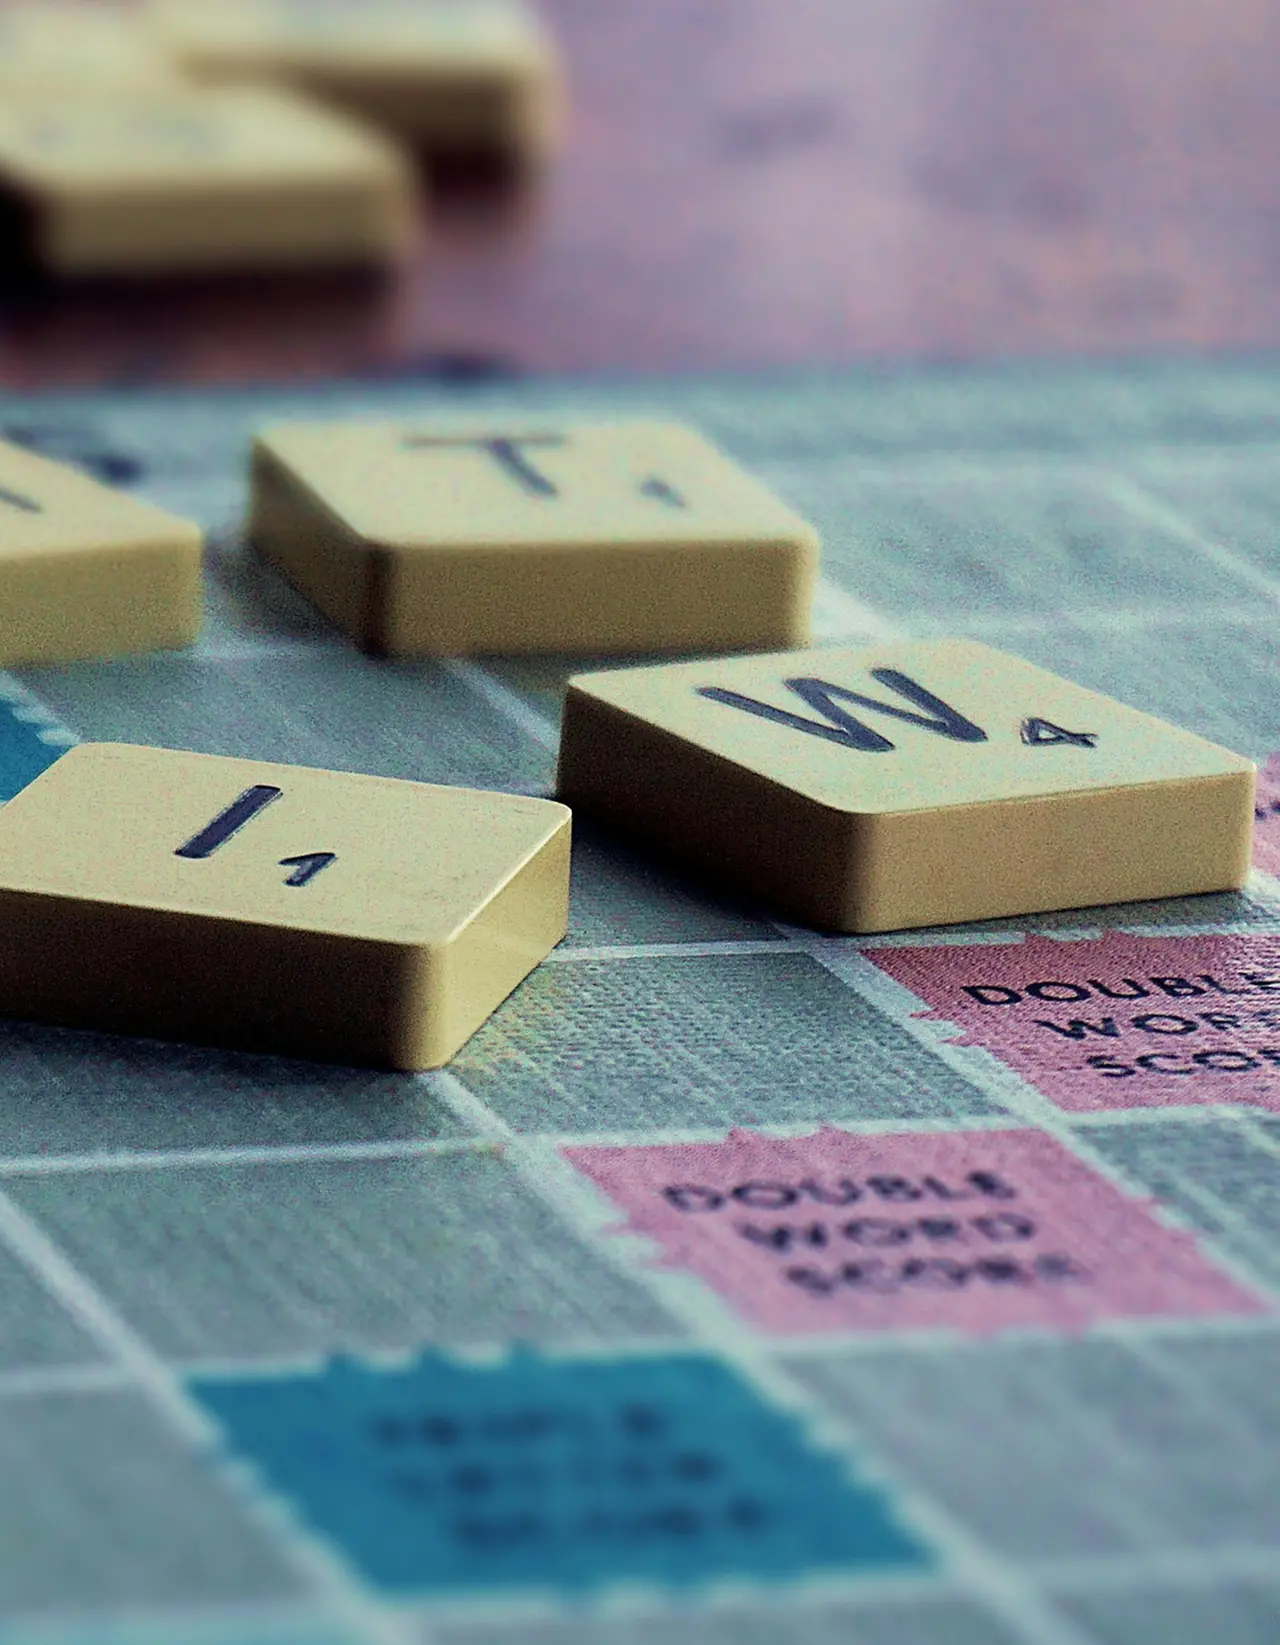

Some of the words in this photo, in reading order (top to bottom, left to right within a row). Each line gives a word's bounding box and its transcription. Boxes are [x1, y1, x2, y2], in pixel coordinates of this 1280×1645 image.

[395, 434, 570, 497] T
[694, 667, 989, 753] W
[1019, 716, 1100, 750] 4
[172, 784, 283, 859] I
[277, 851, 338, 888] 1
[661, 1170, 1017, 1213] DOUBLE
